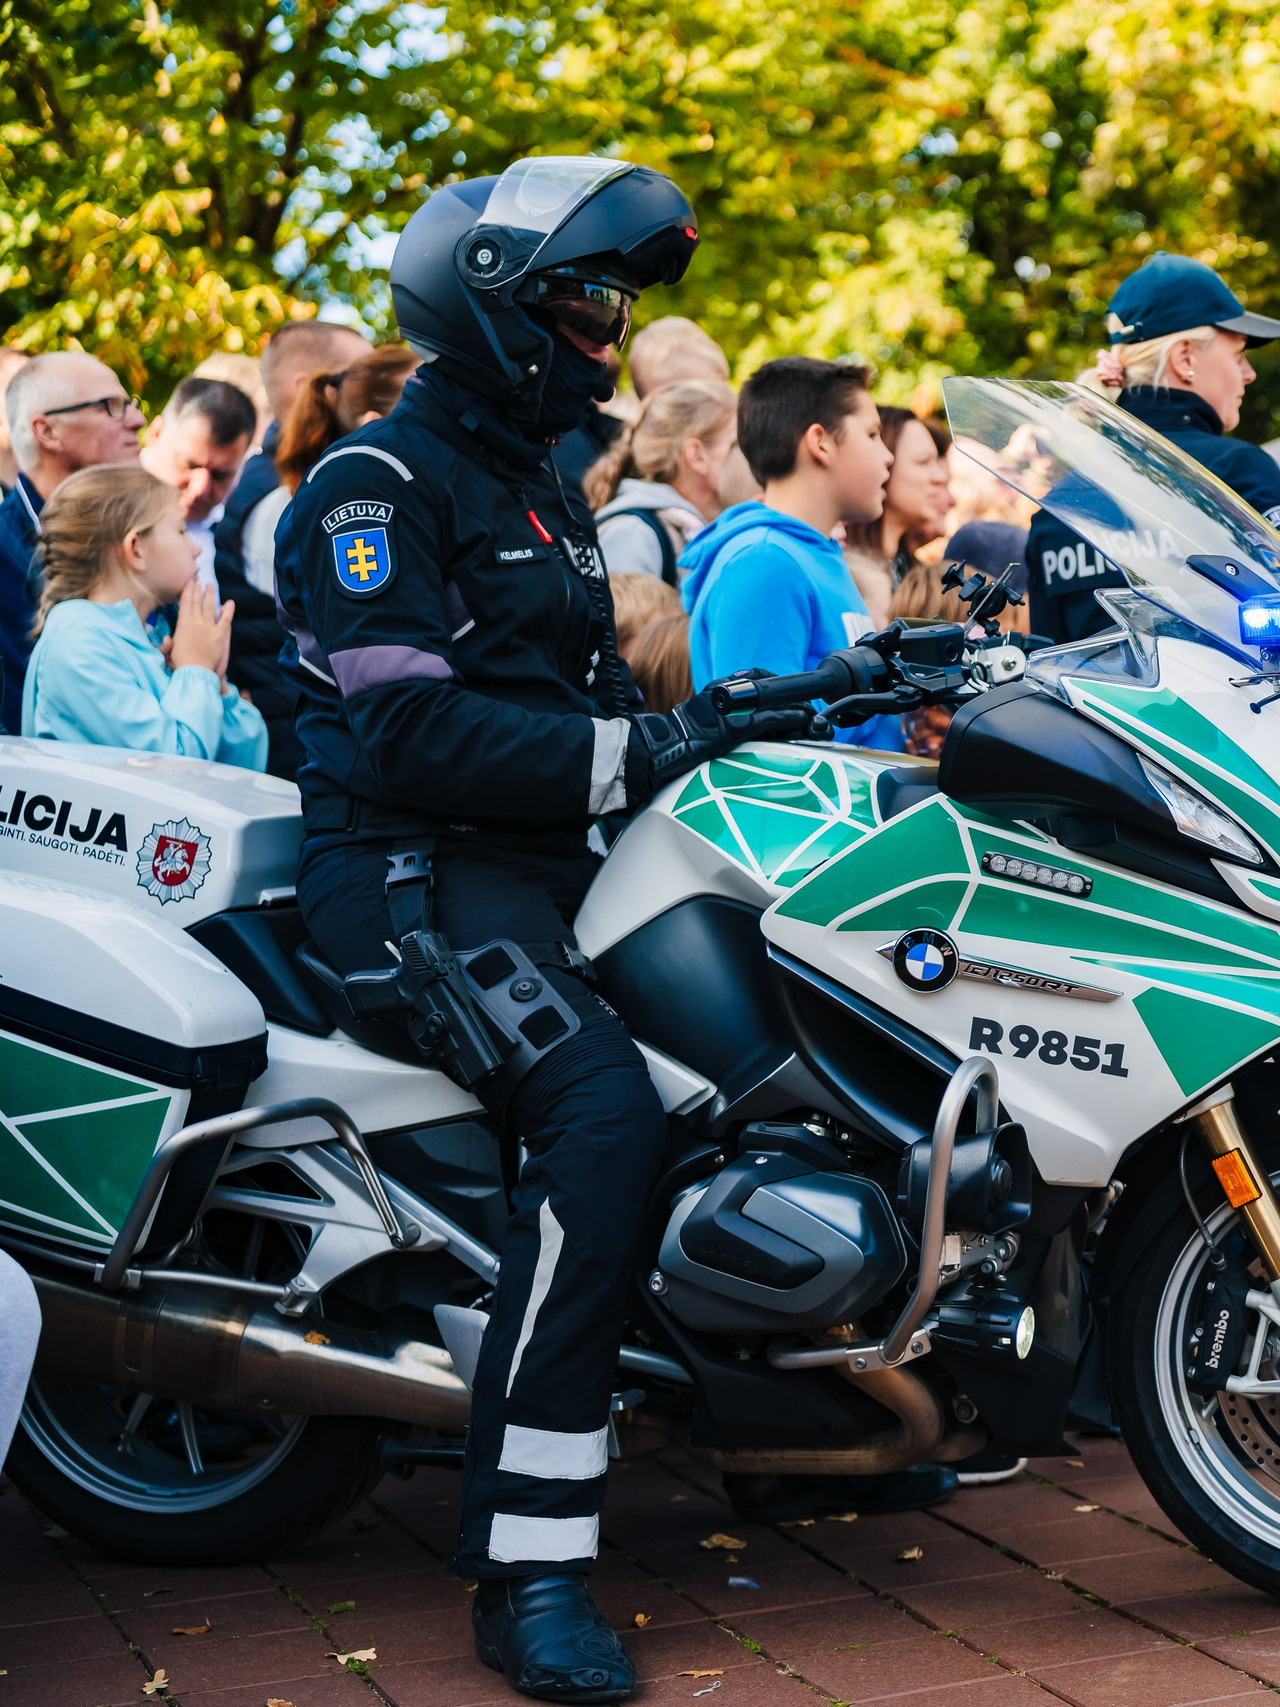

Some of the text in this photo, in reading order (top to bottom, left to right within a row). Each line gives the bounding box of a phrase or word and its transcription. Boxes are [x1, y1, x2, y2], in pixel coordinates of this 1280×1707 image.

[326, 504, 386, 528] LIETUVA
[1042, 529, 1185, 586] POLICIJA
[29, 833, 79, 855] SAUGOTI.
[83, 846, 125, 866] PADĖTI.
[902, 932, 953, 957] BMW
[968, 1016, 1130, 1078] R9851
[1205, 1309, 1230, 1369] brembo
